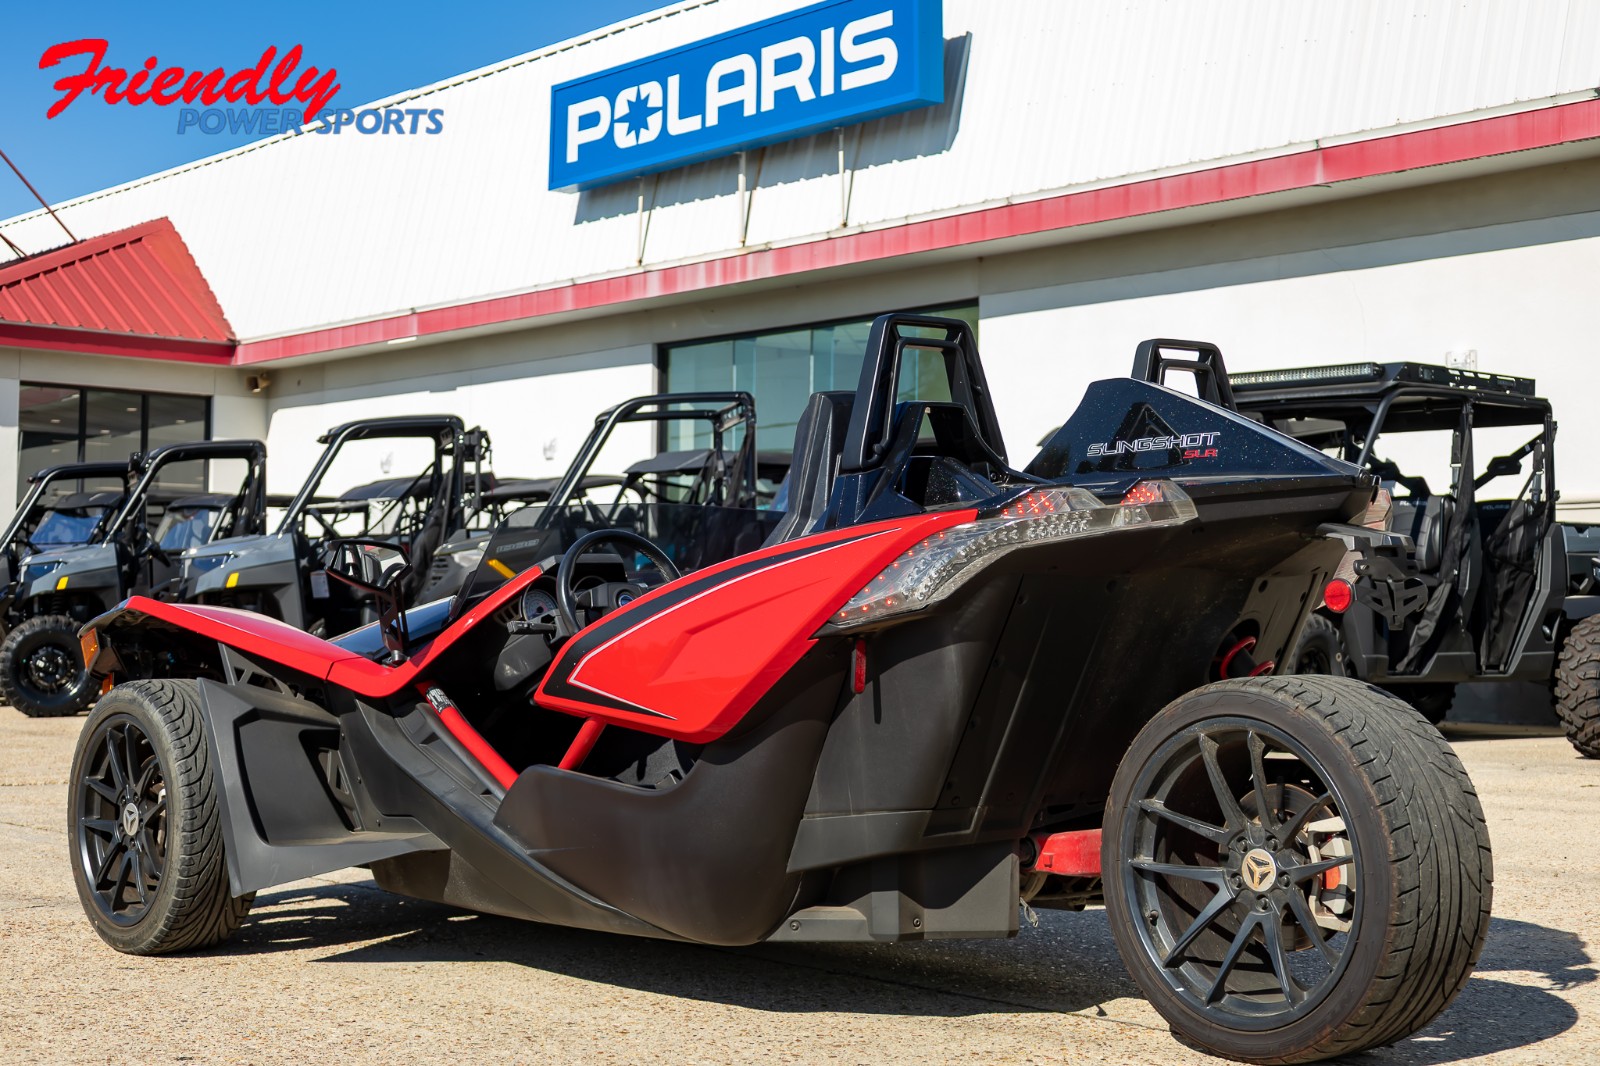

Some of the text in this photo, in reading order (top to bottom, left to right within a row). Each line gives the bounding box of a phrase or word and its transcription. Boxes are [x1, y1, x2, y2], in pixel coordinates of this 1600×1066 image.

[565, 9, 899, 164] POLARIS
[1087, 431, 1221, 457] SLINGSHOT
[1183, 447, 1218, 459] SLR
